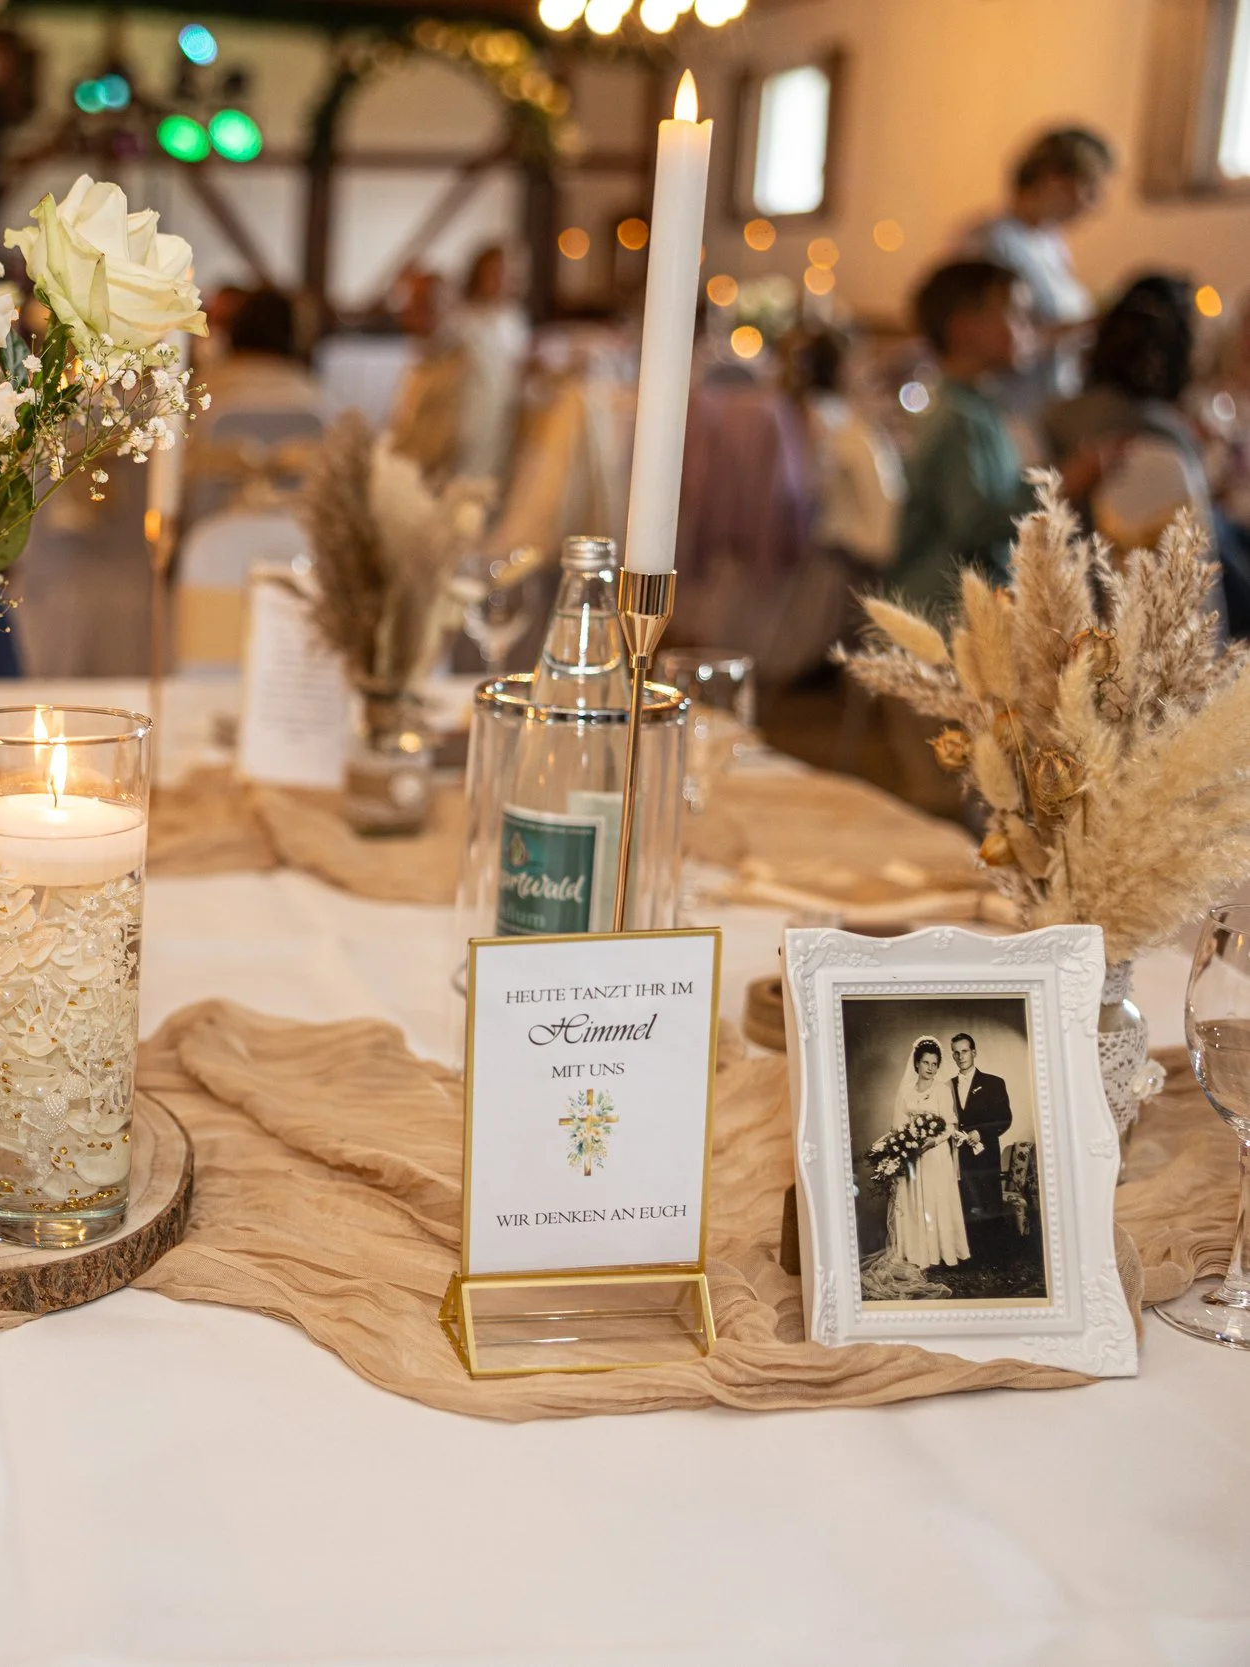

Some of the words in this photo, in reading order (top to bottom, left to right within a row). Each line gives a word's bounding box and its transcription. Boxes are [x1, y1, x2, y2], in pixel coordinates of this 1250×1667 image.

[507, 989, 565, 1003] HEUTE
[571, 985, 631, 1000] TANZT
[637, 984, 666, 996] IHR
[673, 982, 692, 994] IM
[528, 1013, 657, 1045] Himmel
[552, 1065, 585, 1078] MIT
[590, 1063, 624, 1076] UNS
[497, 1214, 530, 1227] WIR
[536, 1210, 605, 1224] DENKEN
[611, 1208, 635, 1220] AN
[640, 1205, 686, 1219] EUCH
